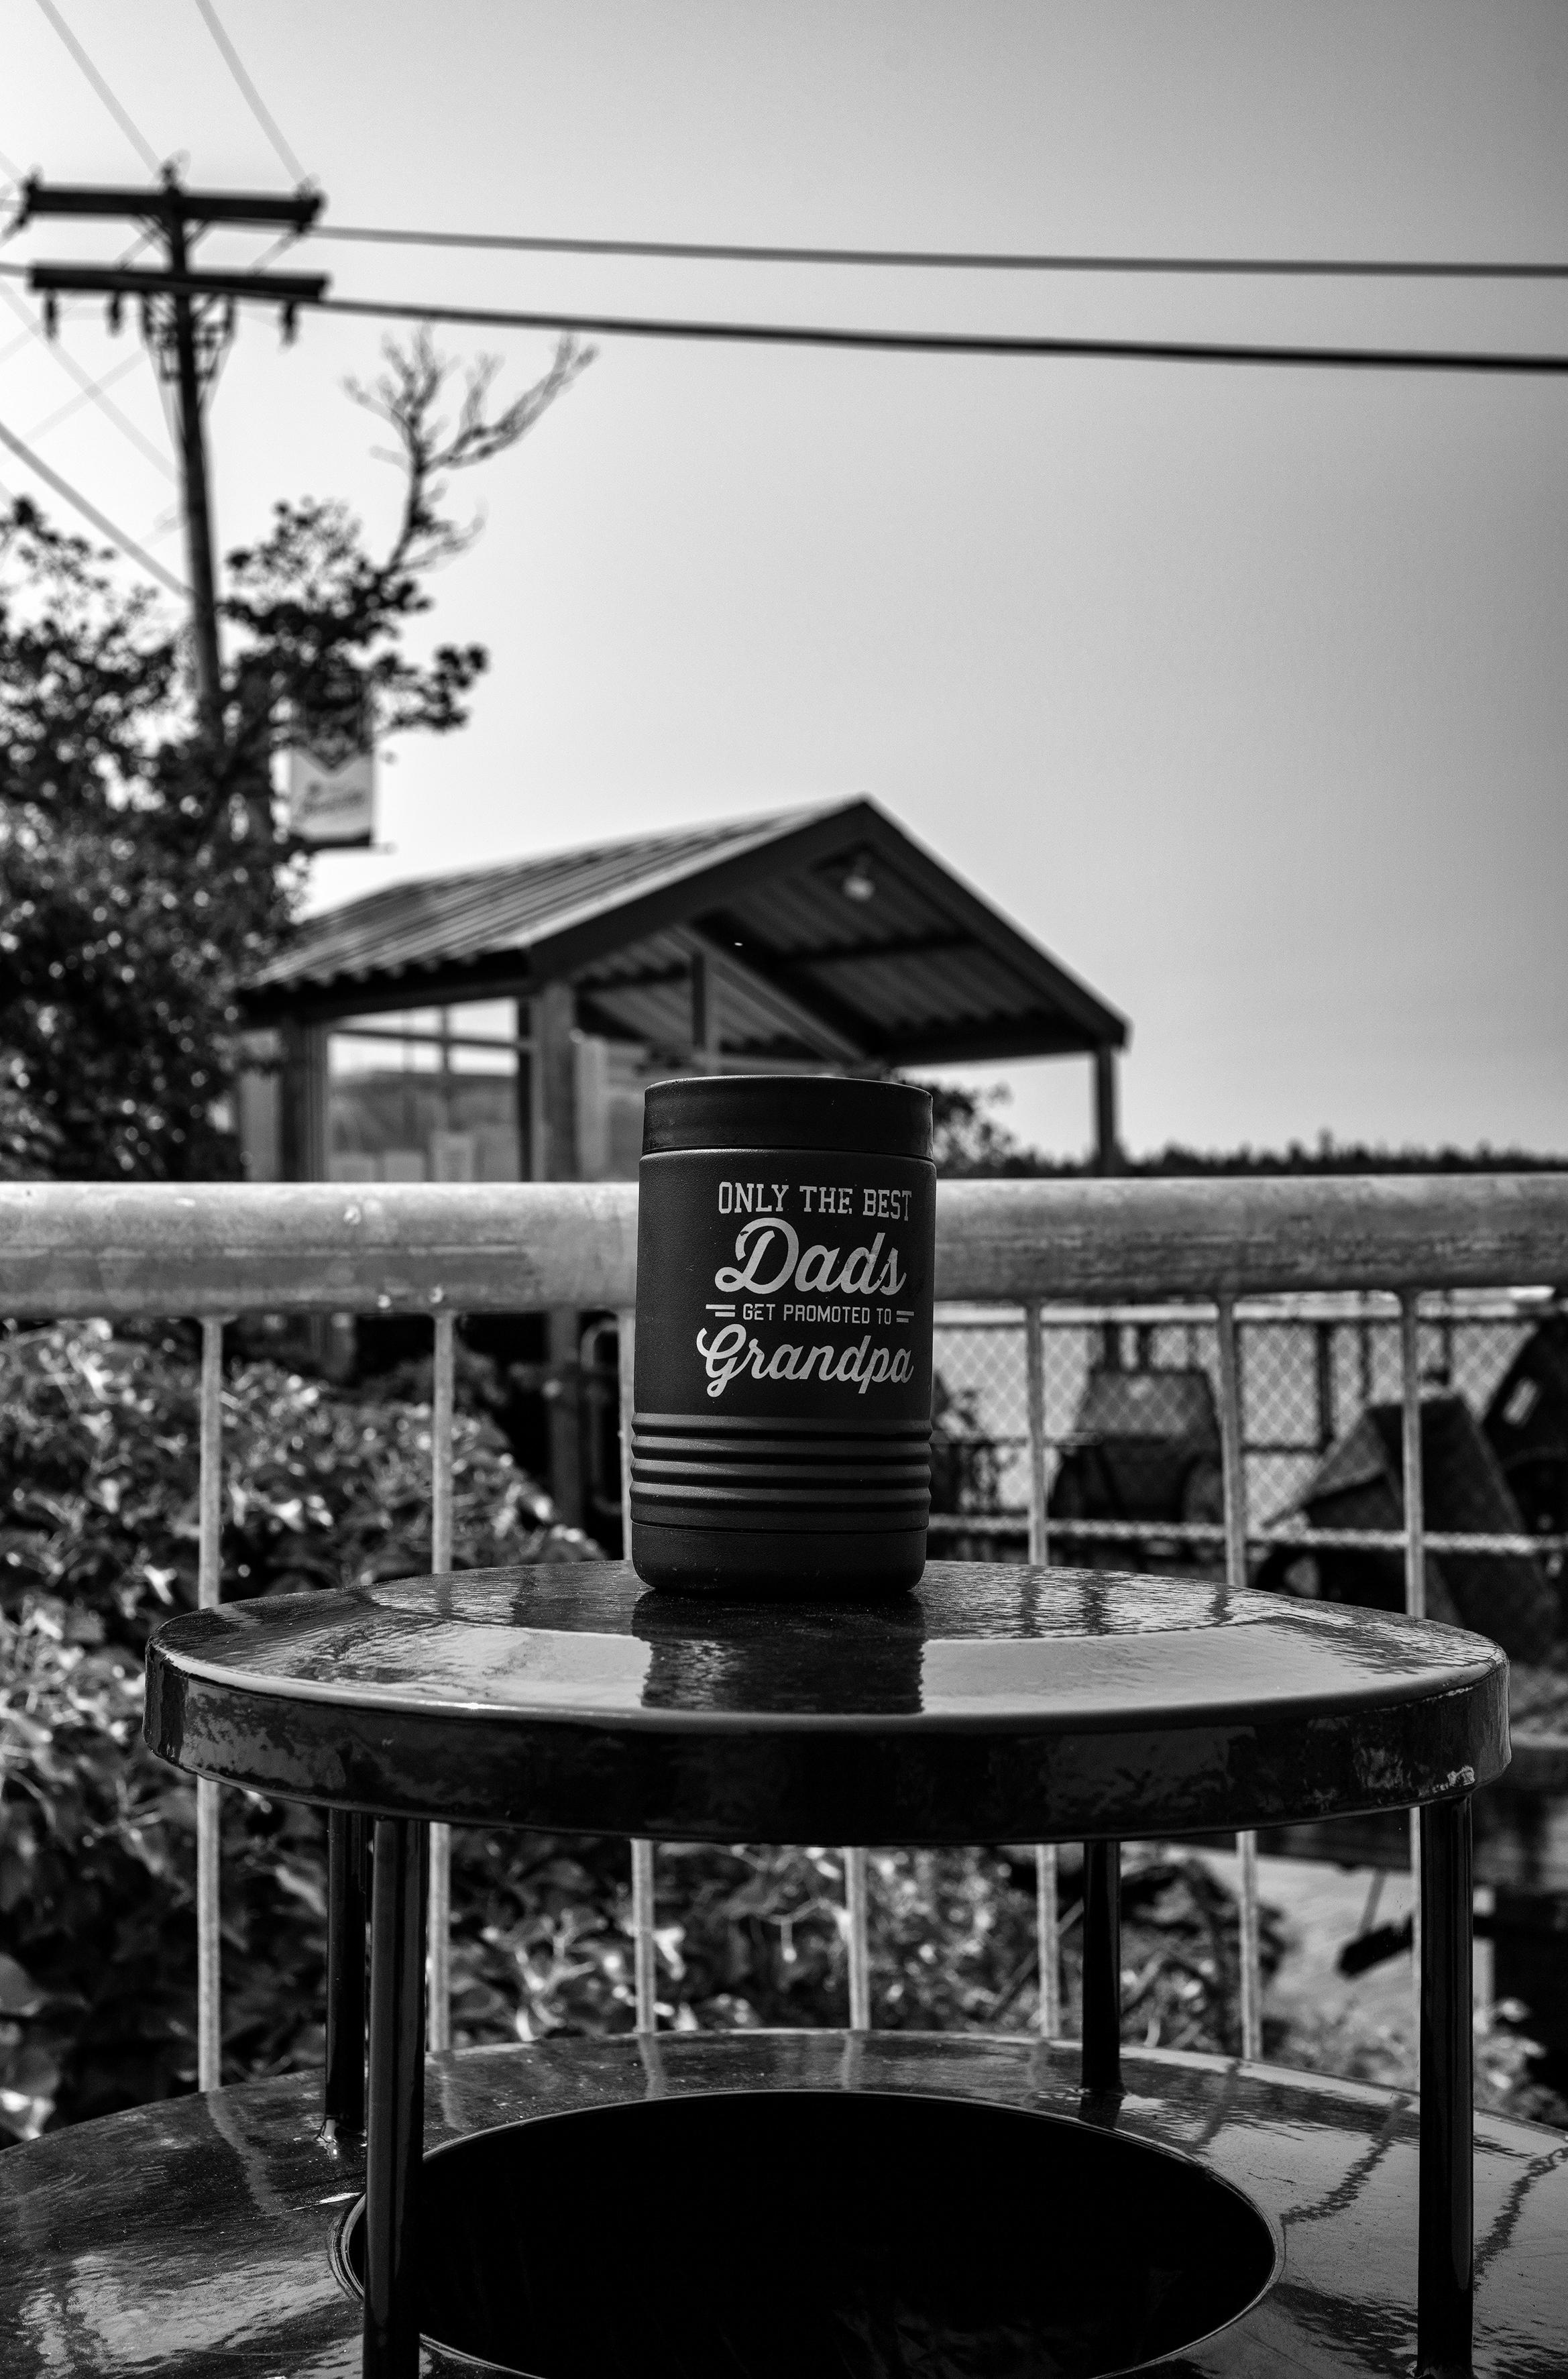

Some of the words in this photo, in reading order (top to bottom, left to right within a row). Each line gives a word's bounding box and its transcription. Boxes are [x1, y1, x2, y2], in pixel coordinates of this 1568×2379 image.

[718, 1182, 789, 1214] ONLY
[799, 1186, 853, 1215] THE
[863, 1188, 912, 1221] BEST
[714, 1217, 907, 1295] Dads
[742, 1303, 776, 1321] GET
[783, 1304, 870, 1324] PROMOTED
[877, 1308, 891, 1325] TO
[696, 1323, 914, 1398] Grandpa
